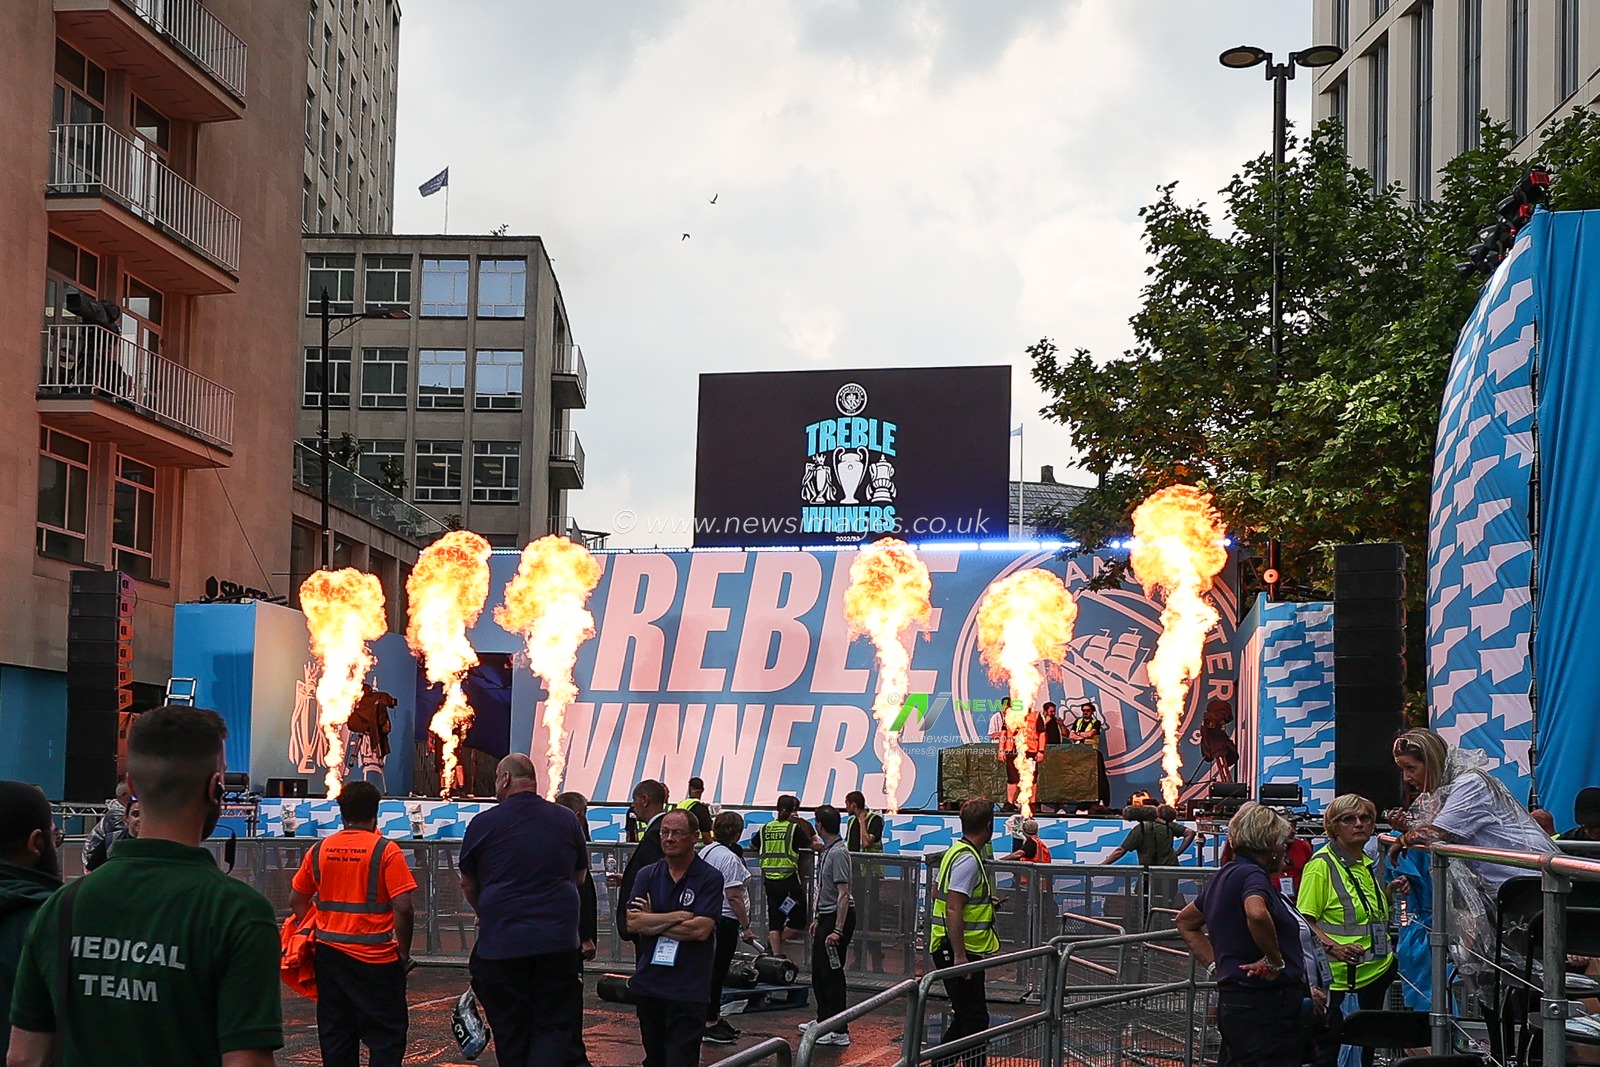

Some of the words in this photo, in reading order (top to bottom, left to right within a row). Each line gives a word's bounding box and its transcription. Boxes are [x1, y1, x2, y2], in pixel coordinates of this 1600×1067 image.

[805, 415, 897, 457] TREBLE
[802, 505, 896, 532] WINNERS
[540, 551, 961, 694] REBLE
[764, 832, 786, 840] CREW
[79, 974, 158, 1002] TEAM
